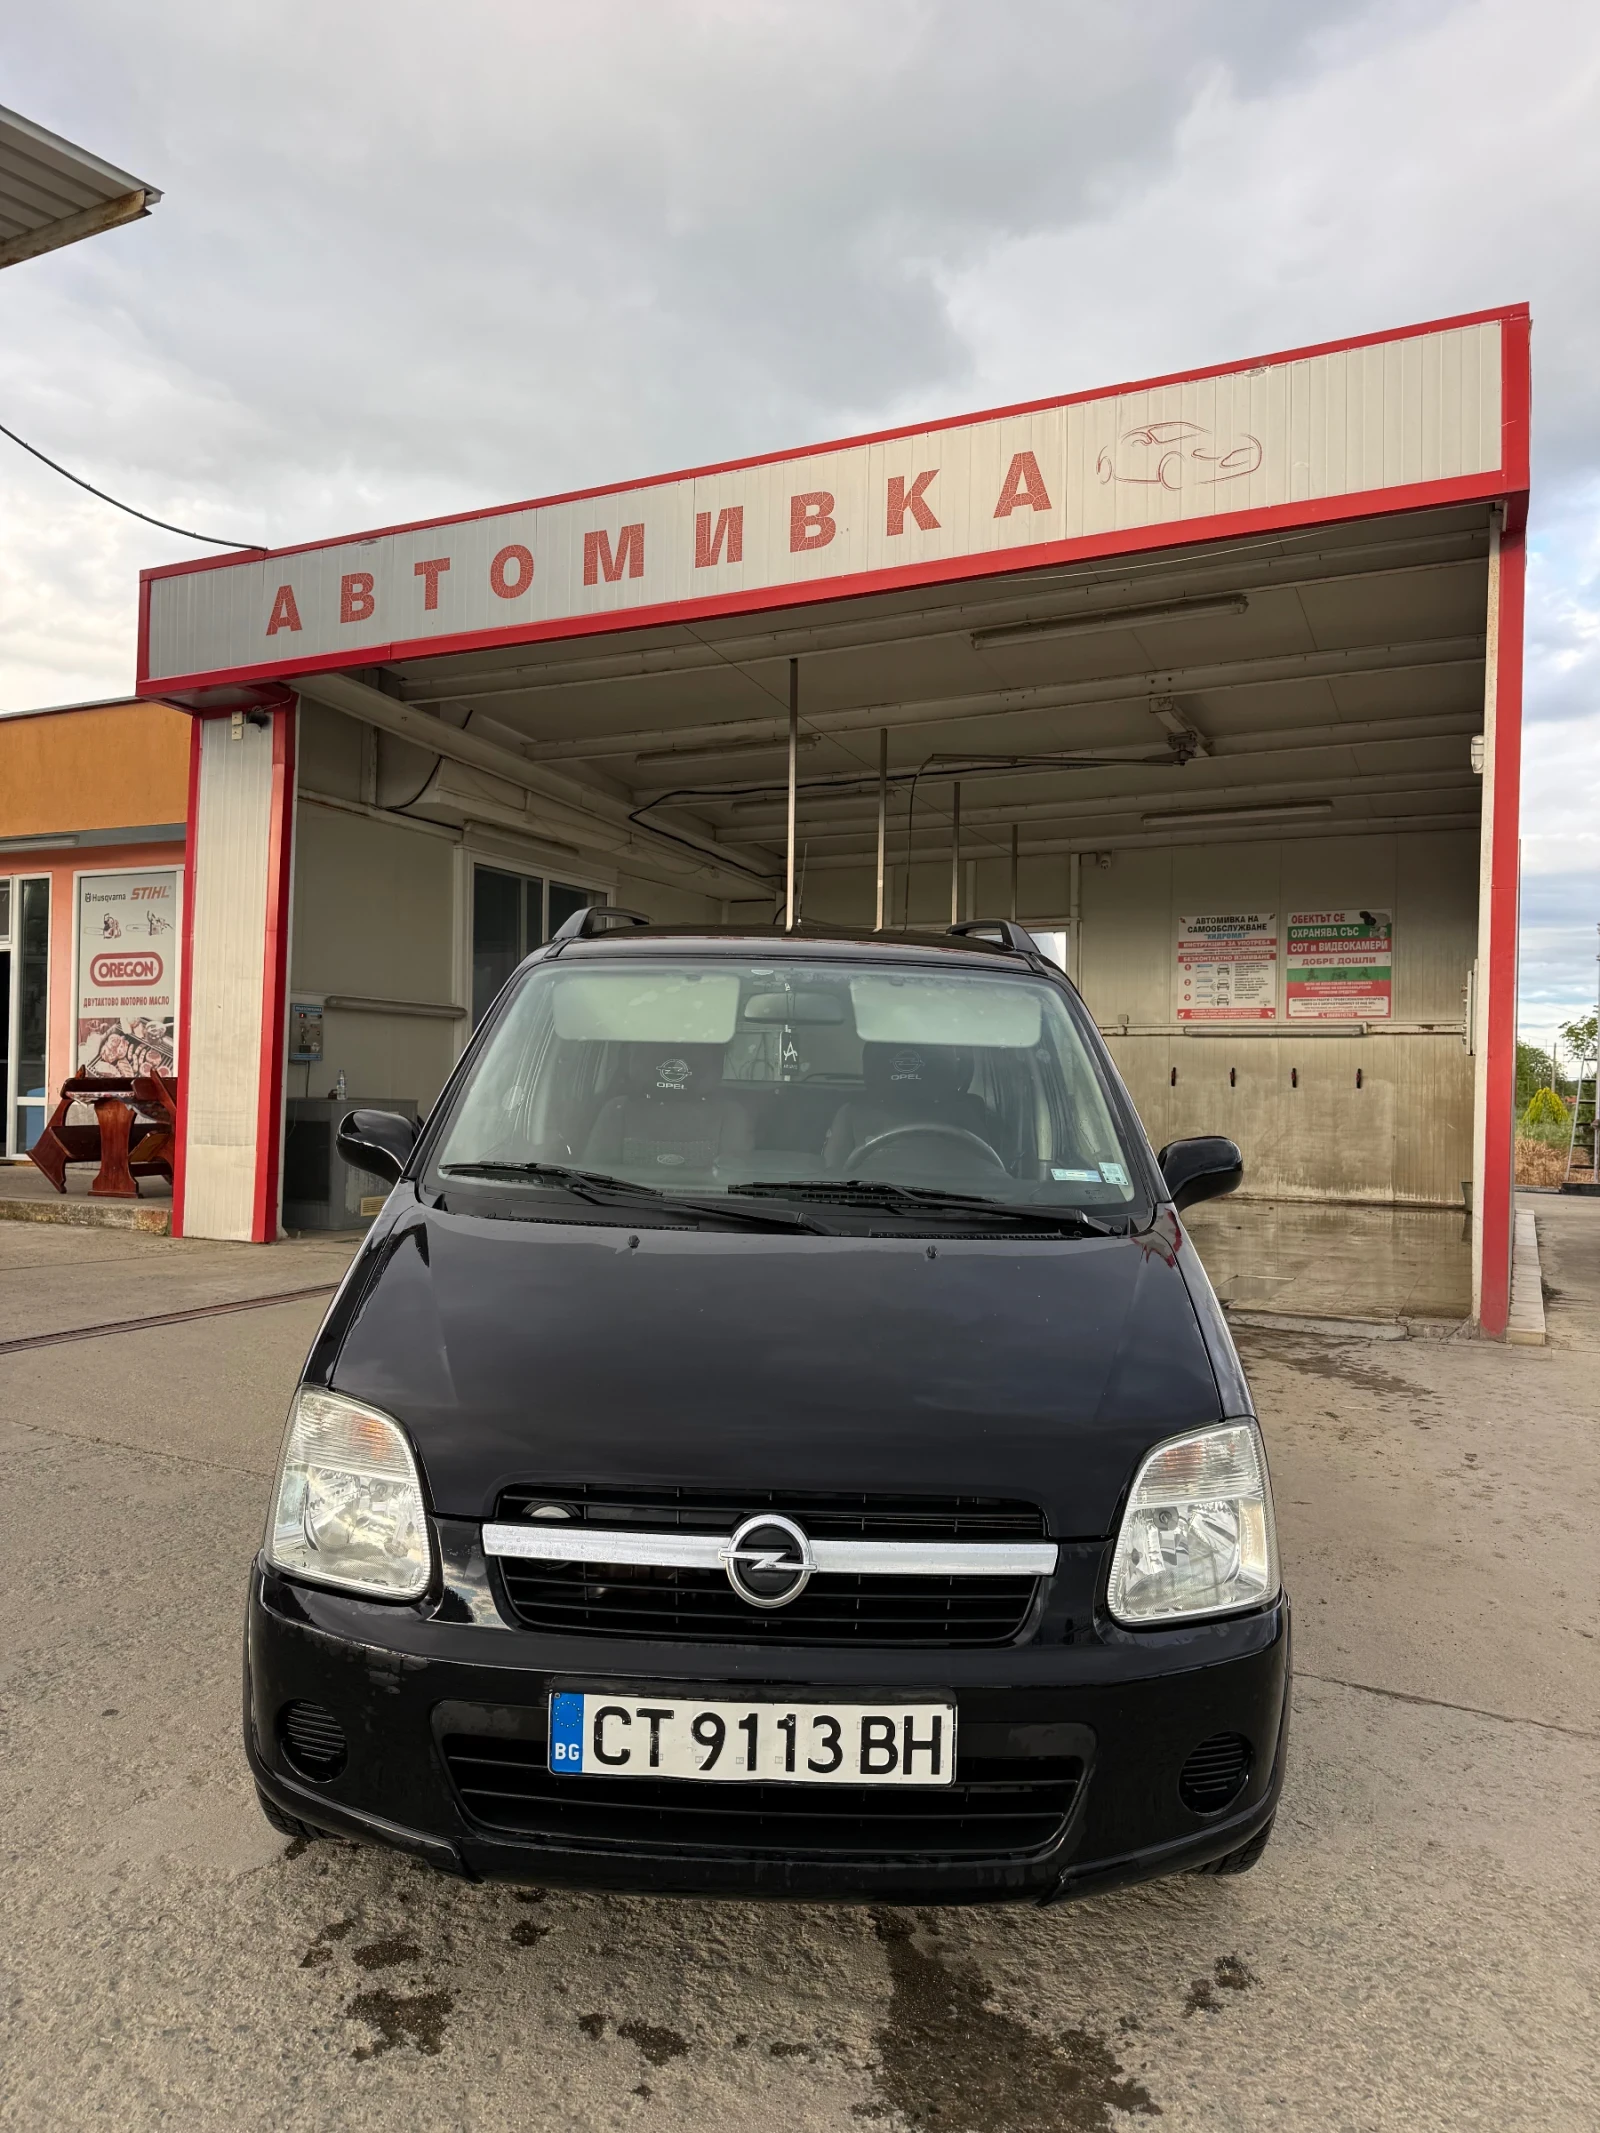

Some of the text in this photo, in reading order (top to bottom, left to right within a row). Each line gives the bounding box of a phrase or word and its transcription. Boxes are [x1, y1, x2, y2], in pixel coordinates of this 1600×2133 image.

[265, 450, 1053, 637] АВТОМИВКА
[92, 893, 126, 902] Husqvarna
[131, 886, 169, 900] STIHL
[1196, 915, 1259, 925] АВТОМИВКА НА
[1291, 913, 1345, 924] ОБЕКТЪТ СЕ
[1187, 923, 1267, 933] САМООБСЛУЖВАНЕ
[1291, 927, 1359, 938] ОХРАНЯВА СЪС
[1291, 943, 1308, 952] СОТ
[1319, 941, 1388, 952] ВИДЕОКАМЕРИ
[1302, 957, 1376, 966] ДОБРЕ ДОШЛИ
[98, 961, 154, 978] OREGON
[83, 996, 170, 1008] ДВУТАКТОВО МОТОРНО МАСЛО
[656, 1082, 687, 1090] OPEL
[554, 1742, 580, 1762] BG
